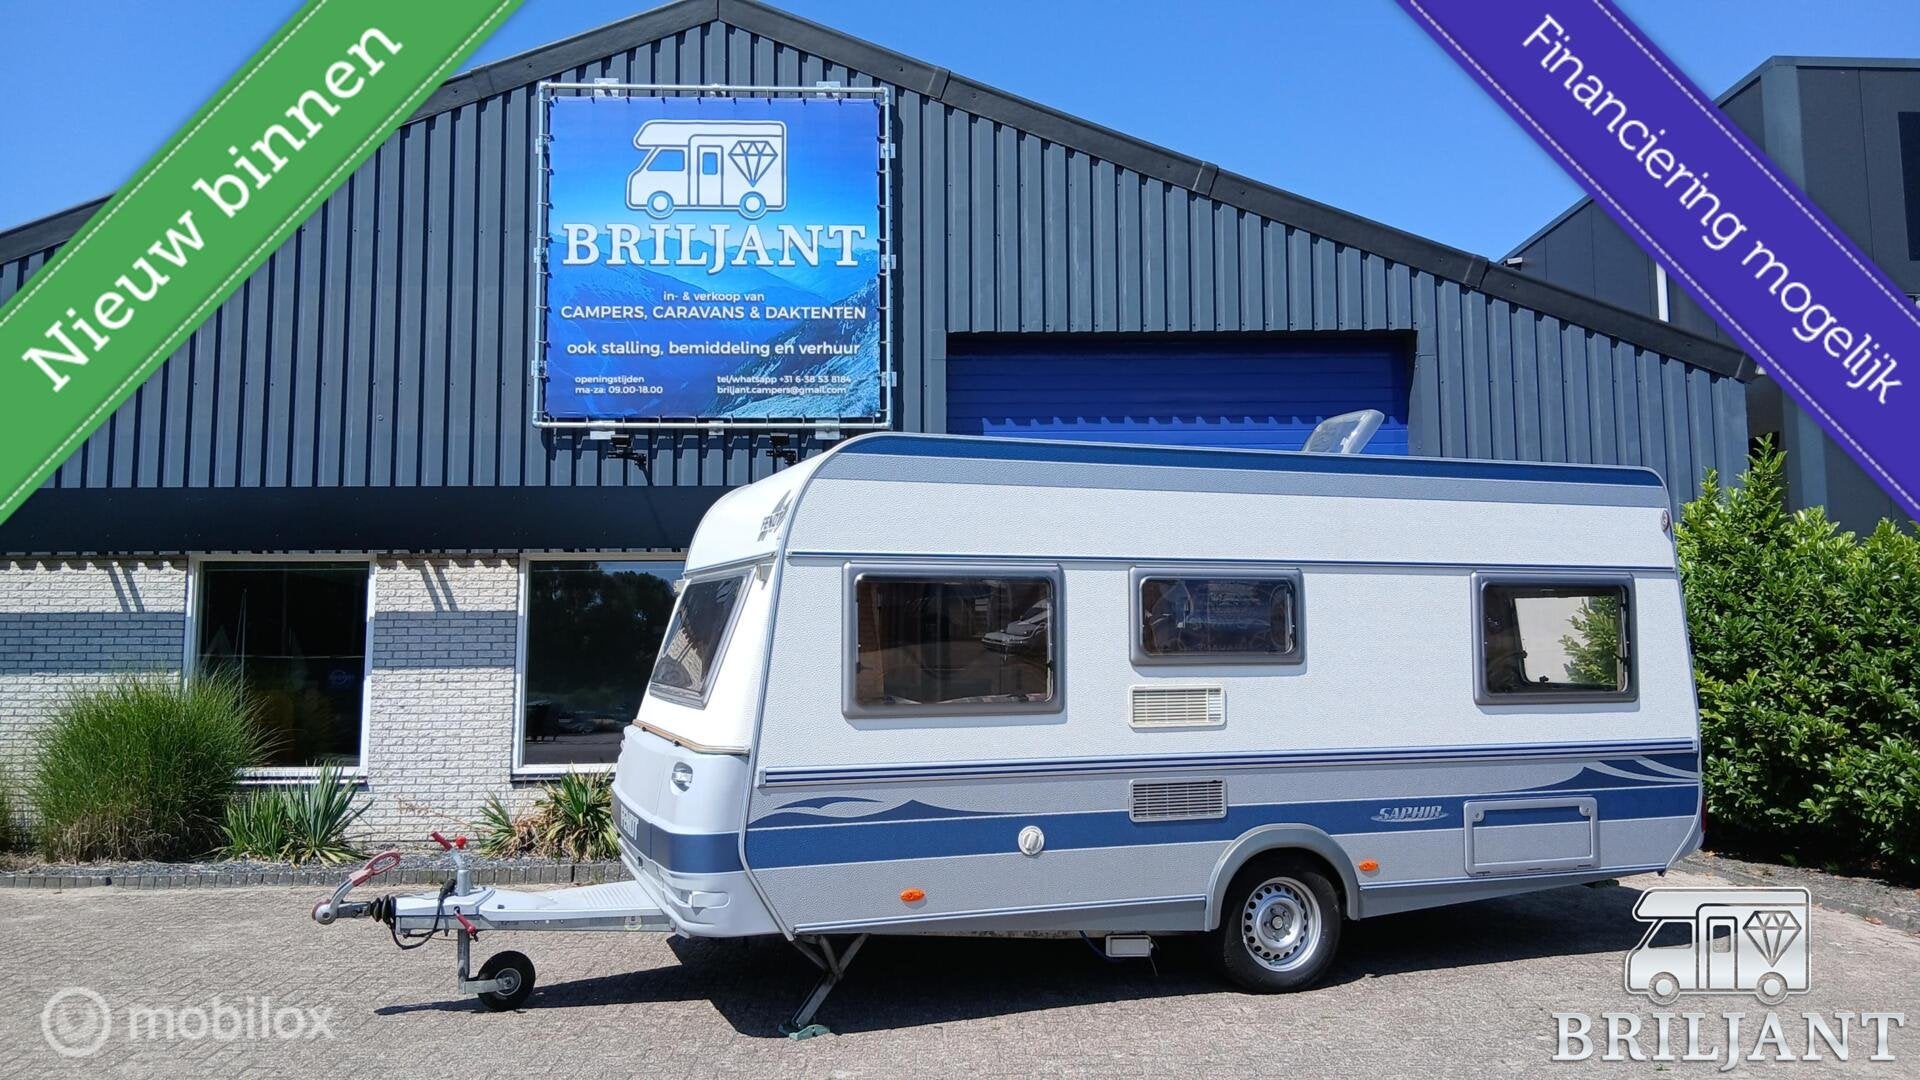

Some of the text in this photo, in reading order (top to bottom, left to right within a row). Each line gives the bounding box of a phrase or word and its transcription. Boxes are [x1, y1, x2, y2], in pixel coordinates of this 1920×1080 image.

[562, 223, 866, 275] BRILJANT
[664, 291, 764, 303] in- & verkoop van
[561, 306, 866, 320] CAMPERS, CARAVANS & DAKTENTEN
[567, 341, 860, 357] ook stalling, bemiddeling en verhuur
[575, 375, 645, 384] openingstijden
[717, 375, 852, 384] tel/whatsapp +31 6-38 53 8184
[575, 385, 663, 394] ma-za: 09.00-18.00
[717, 385, 847, 395] briljant.campers@gmail.com
[1379, 805, 1442, 819] SAPHIR
